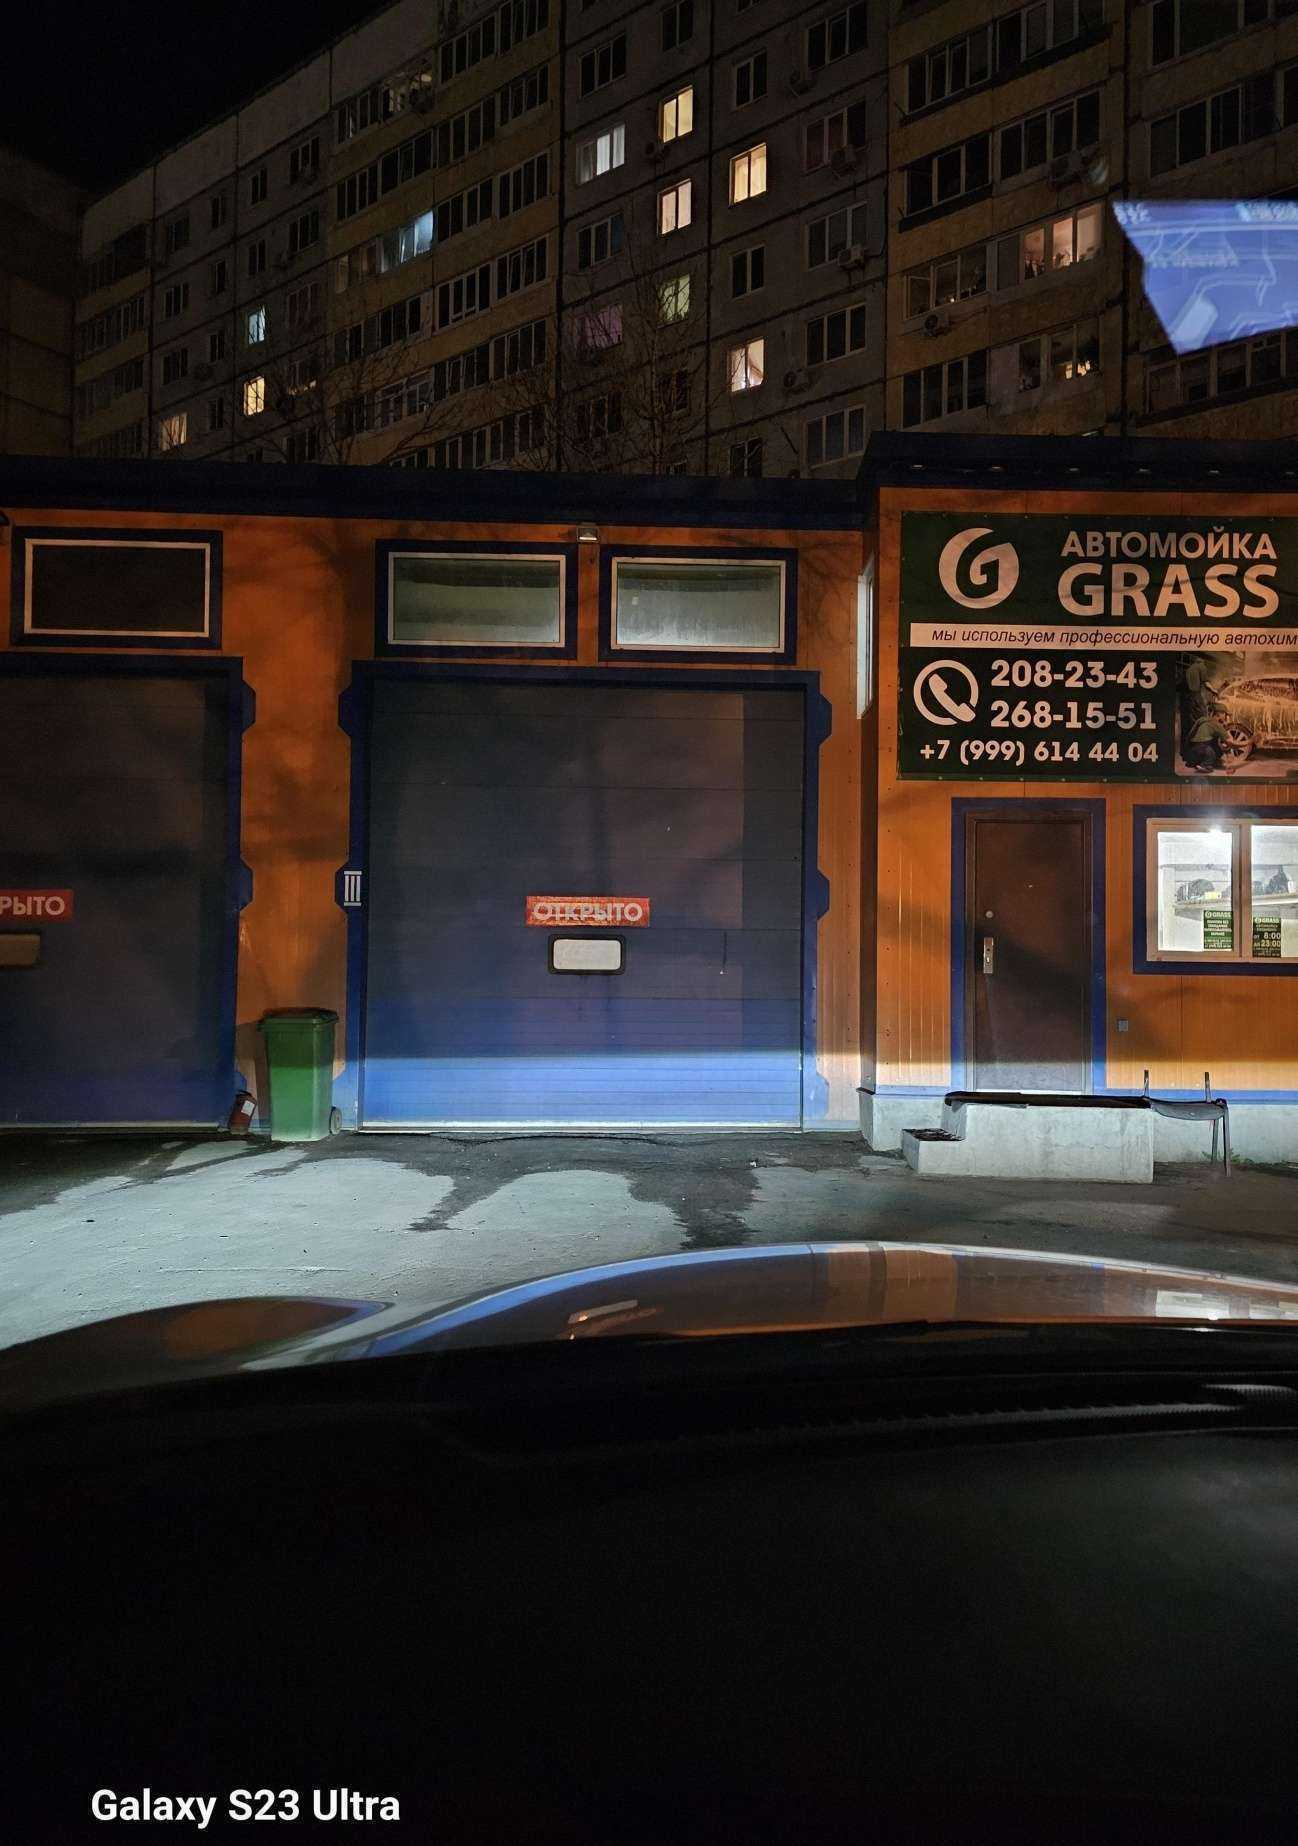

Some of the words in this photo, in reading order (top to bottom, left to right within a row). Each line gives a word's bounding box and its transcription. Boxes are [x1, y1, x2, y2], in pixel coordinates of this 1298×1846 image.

[1060, 526, 1277, 559] АВТОМОЙКА
[1057, 563, 1280, 618] GRASS
[932, 630, 957, 641] мы
[961, 630, 1055, 646] используем
[1059, 630, 1220, 649] профессиональную
[1224, 633, 1298, 645] автохим
[990, 659, 1159, 689] 208-23-43
[990, 700, 1157, 729] 268-15-51
[919, 739, 951, 760] +7
[960, 739, 1025, 766] (999)
[1034, 741, 1080, 762] 614
[1088, 742, 1119, 762] 44
[1127, 742, 1159, 763] 04
[533, 902, 643, 921] ОТКРЫТО
